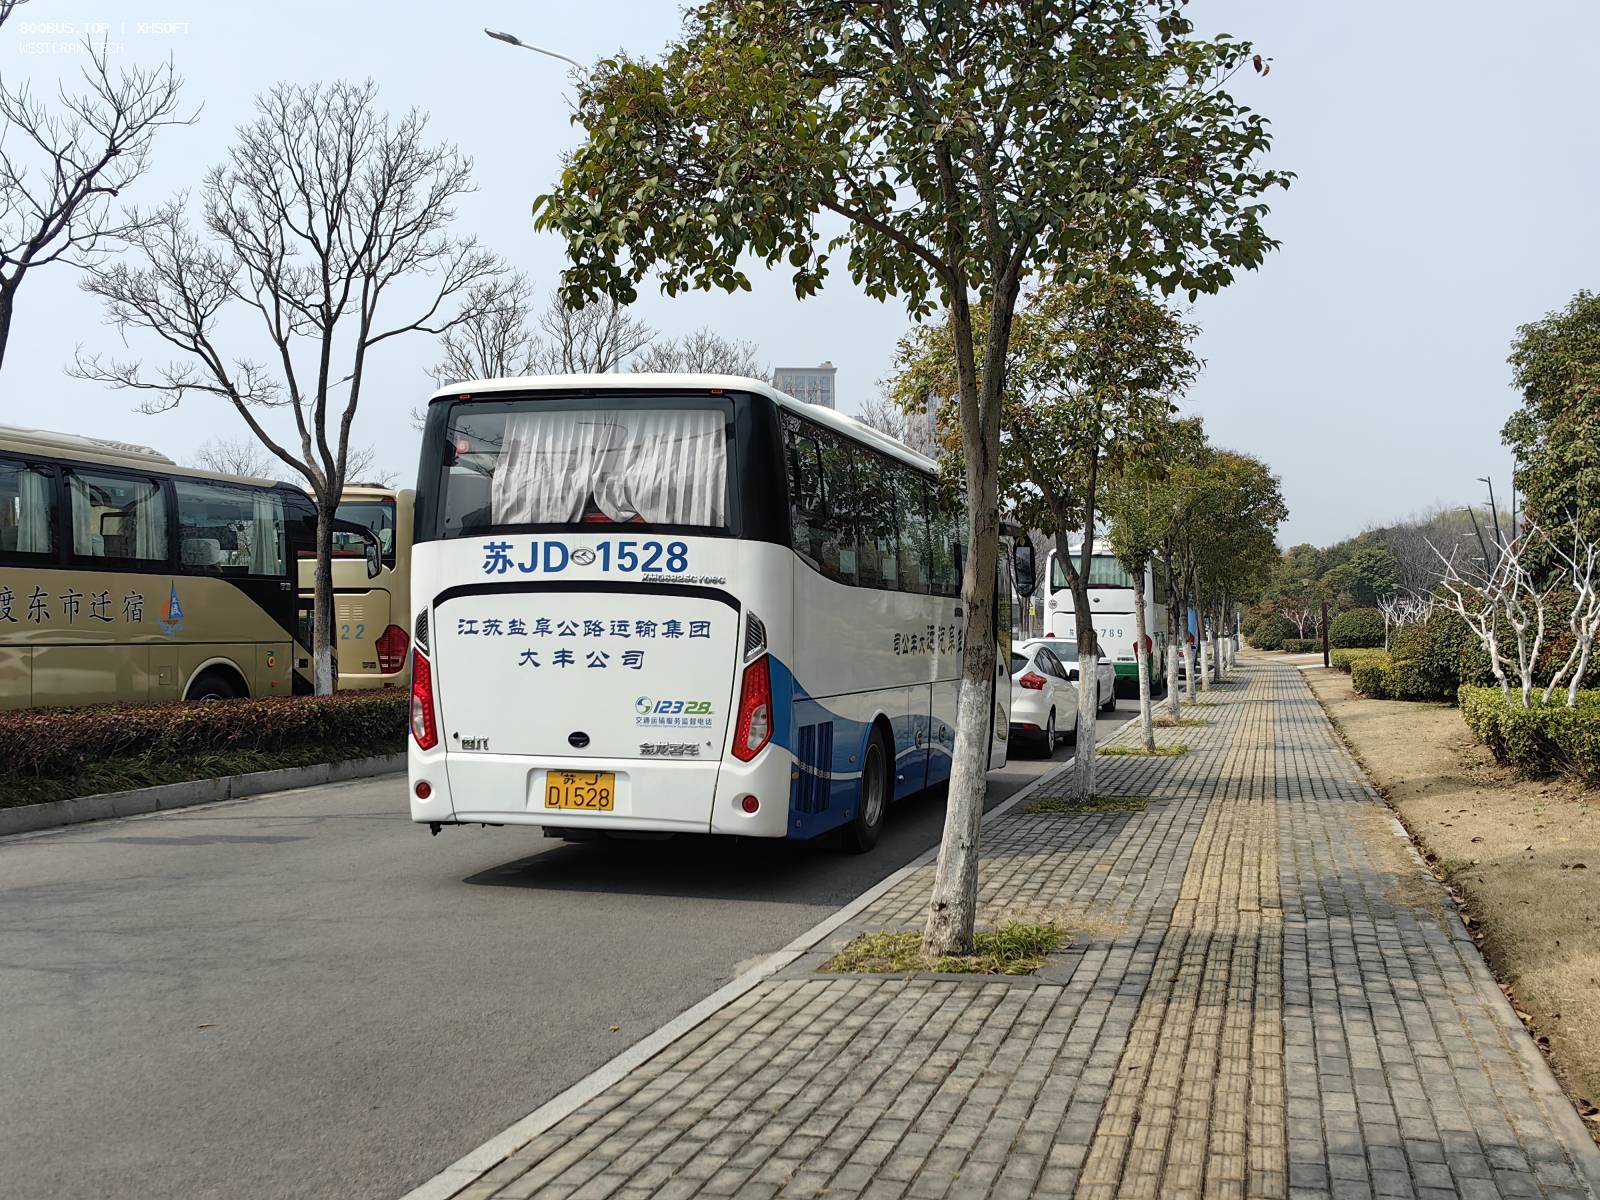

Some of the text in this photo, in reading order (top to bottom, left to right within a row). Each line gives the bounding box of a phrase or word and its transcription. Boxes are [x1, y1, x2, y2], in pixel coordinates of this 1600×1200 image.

[482, 541, 689, 575] 苏JD 1528
[457, 617, 711, 640] 江苏盐阜公路运输集团
[1094, 628, 1123, 638] 789
[518, 648, 645, 670] 大丰公司
[653, 700, 712, 714] 12328
[636, 717, 713, 725] 交通运输服务监督电话
[548, 786, 610, 808] D1528
